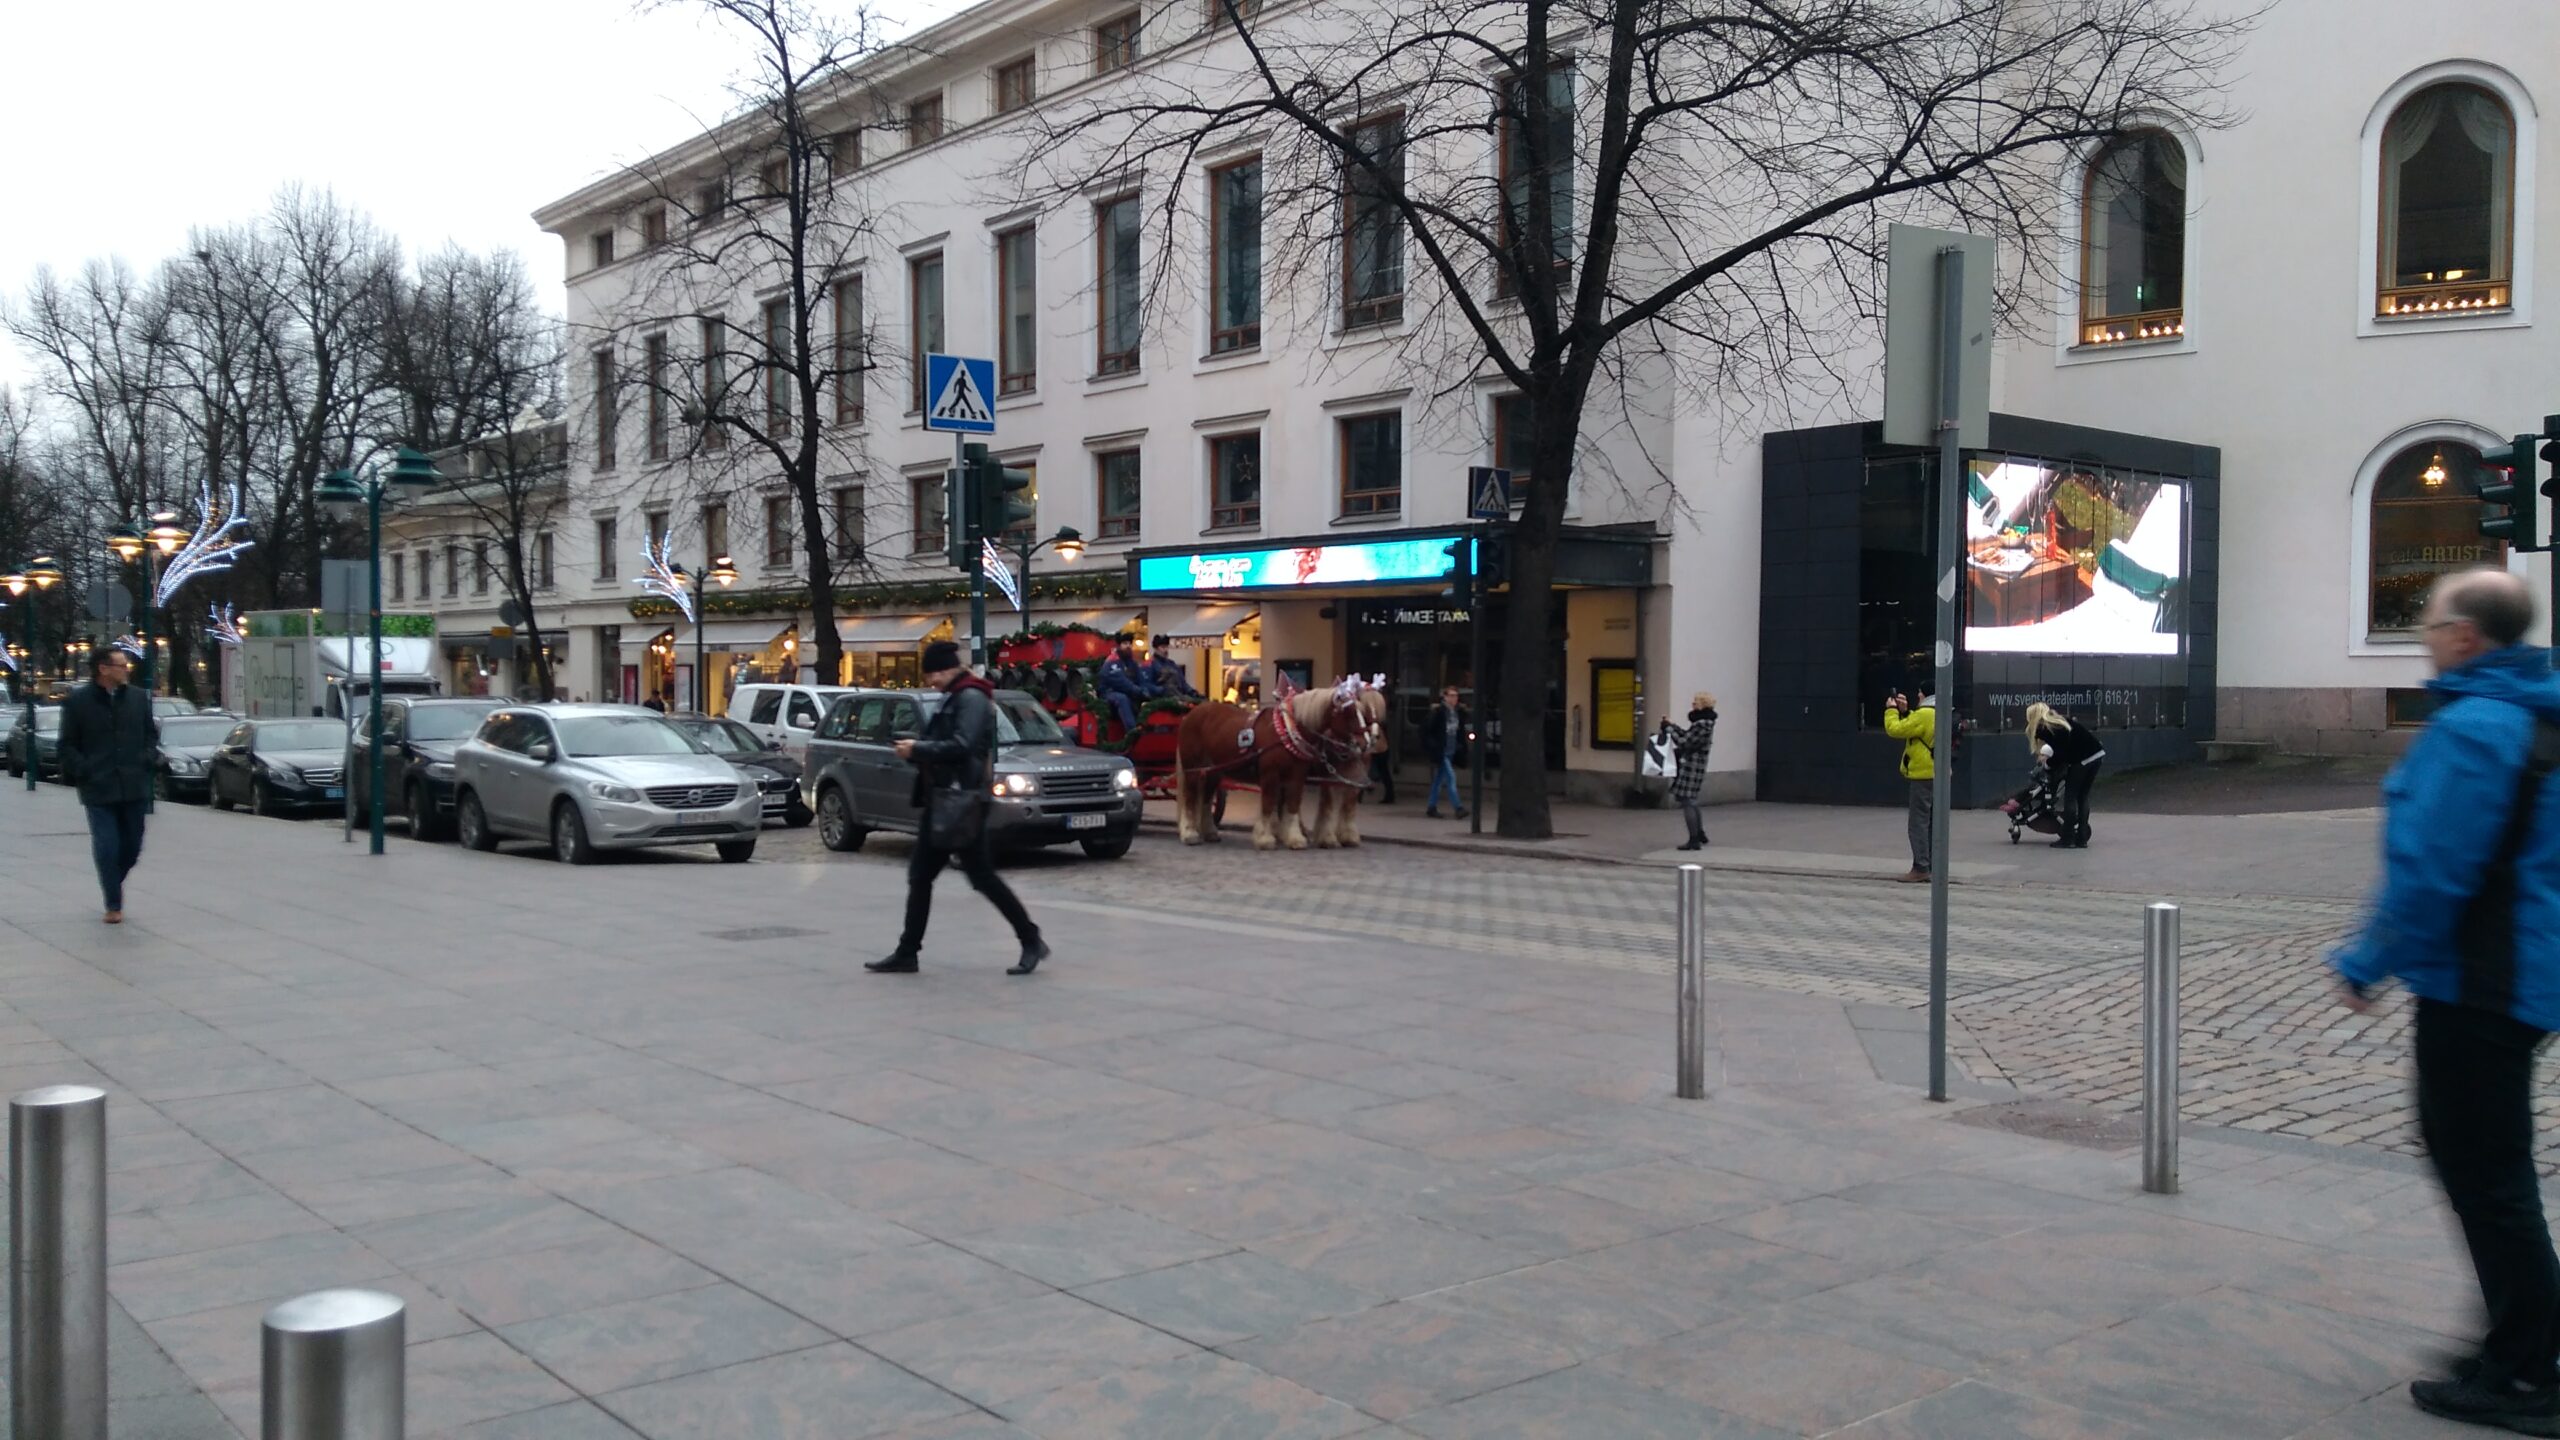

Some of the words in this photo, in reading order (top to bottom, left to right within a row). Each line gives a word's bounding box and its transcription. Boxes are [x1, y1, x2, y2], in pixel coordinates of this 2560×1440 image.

[2422, 545, 2482, 561] ARTIST
[1174, 636, 1212, 649] CHANEL
[2105, 690, 2122, 705] 616
